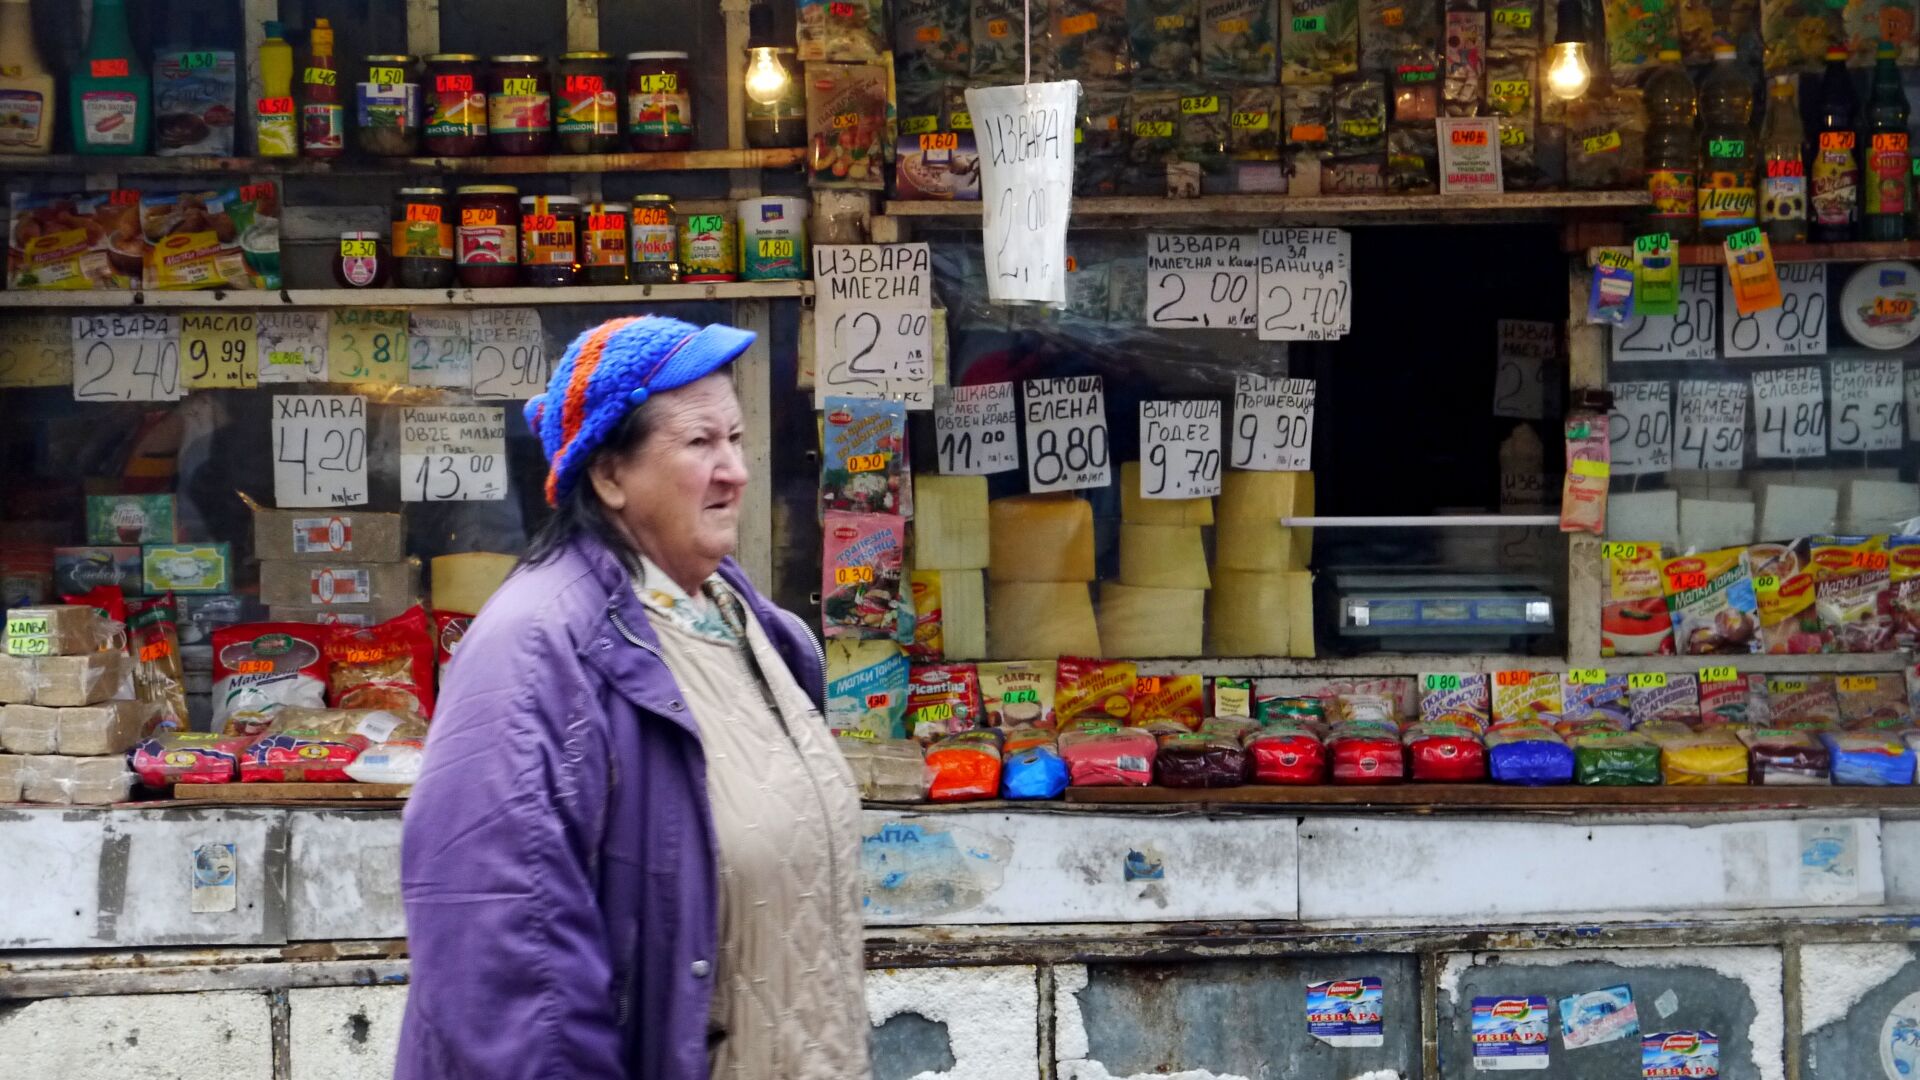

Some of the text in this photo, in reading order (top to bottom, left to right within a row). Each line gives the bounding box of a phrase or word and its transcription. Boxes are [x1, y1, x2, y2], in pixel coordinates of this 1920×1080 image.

[1496, 11, 1529, 27] 0.25
[371, 68, 403, 84] 1.50
[506, 80, 537, 95] 1.40
[1494, 83, 1526, 97] 0.25
[258, 99, 290, 113] 0.50
[1183, 99, 1212, 114] 0.30
[1233, 112, 1263, 128] 0.30
[921, 134, 954, 151] 1.60
[985, 109, 1060, 167] ИЗВАРА
[408, 206, 441, 222] 1.40
[1156, 236, 1240, 255] ИЗВАРА
[1262, 229, 1338, 247] СИРЕНЕ
[1637, 233, 1670, 254] 0.40
[1729, 233, 1758, 251] 0.40
[342, 241, 376, 256] 2.30
[1287, 246, 1308, 260] ЗА
[818, 247, 929, 277] ИЗВАРА
[1260, 257, 1335, 280] БАНИЦА
[79, 317, 169, 340] ИЗВАРА
[182, 315, 253, 334] МАСЛО
[1753, 366, 1820, 388] СИРЕНЕ
[1832, 360, 1900, 377] СИРЕНЕ
[1025, 377, 1103, 399] ВИТОША
[1238, 376, 1315, 399] ВИТОША
[1613, 382, 1669, 402] ИРЕНЕ
[1680, 380, 1747, 399] СИРЕНЕ
[1759, 383, 1820, 400] СЛИВЕН
[1832, 375, 1896, 393] СМОЛЯН
[278, 397, 365, 420] ХАЛВА
[1028, 394, 1097, 423] ЕЛЕНА
[1142, 399, 1220, 420] ВИТОША
[1680, 399, 1744, 416] КАМЕН
[403, 409, 487, 425] Кашкавал
[849, 455, 883, 471] 0.30
[838, 567, 872, 584] 0.30
[10, 622, 48, 636] ХАЛВА
[1310, 1012, 1379, 1023] ИЗВАРА
[1476, 1032, 1546, 1043] ИЗВАРА
[1647, 1066, 1717, 1078] ИЗВАРА
